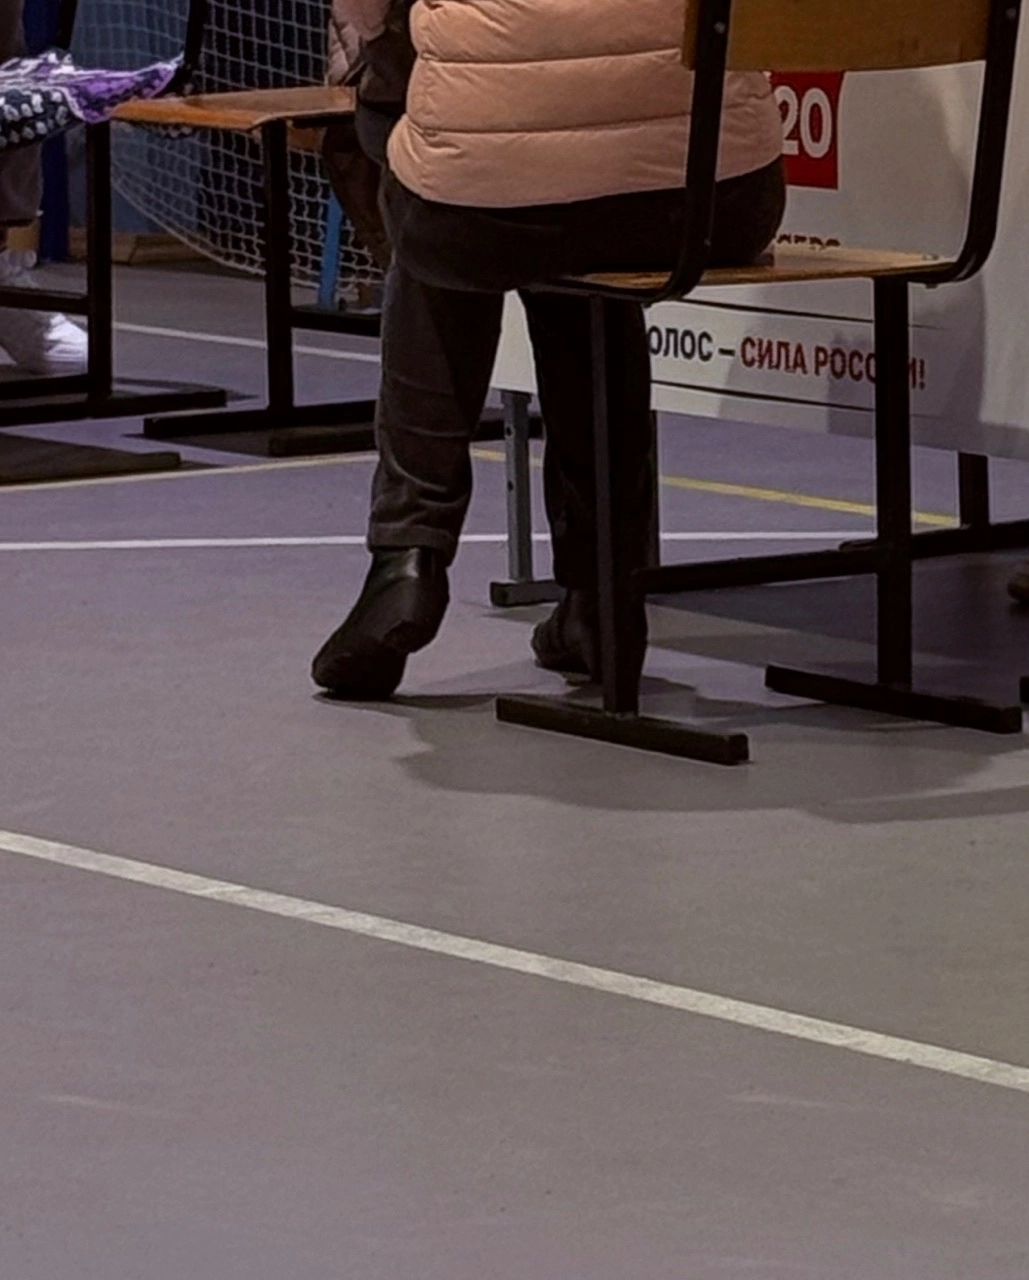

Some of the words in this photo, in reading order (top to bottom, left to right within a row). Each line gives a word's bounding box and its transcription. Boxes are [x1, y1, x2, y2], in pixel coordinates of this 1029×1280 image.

[774, 86, 832, 158] 20
[740, 336, 808, 375] СИЛА
[815, 348, 925, 390] РОСС!
